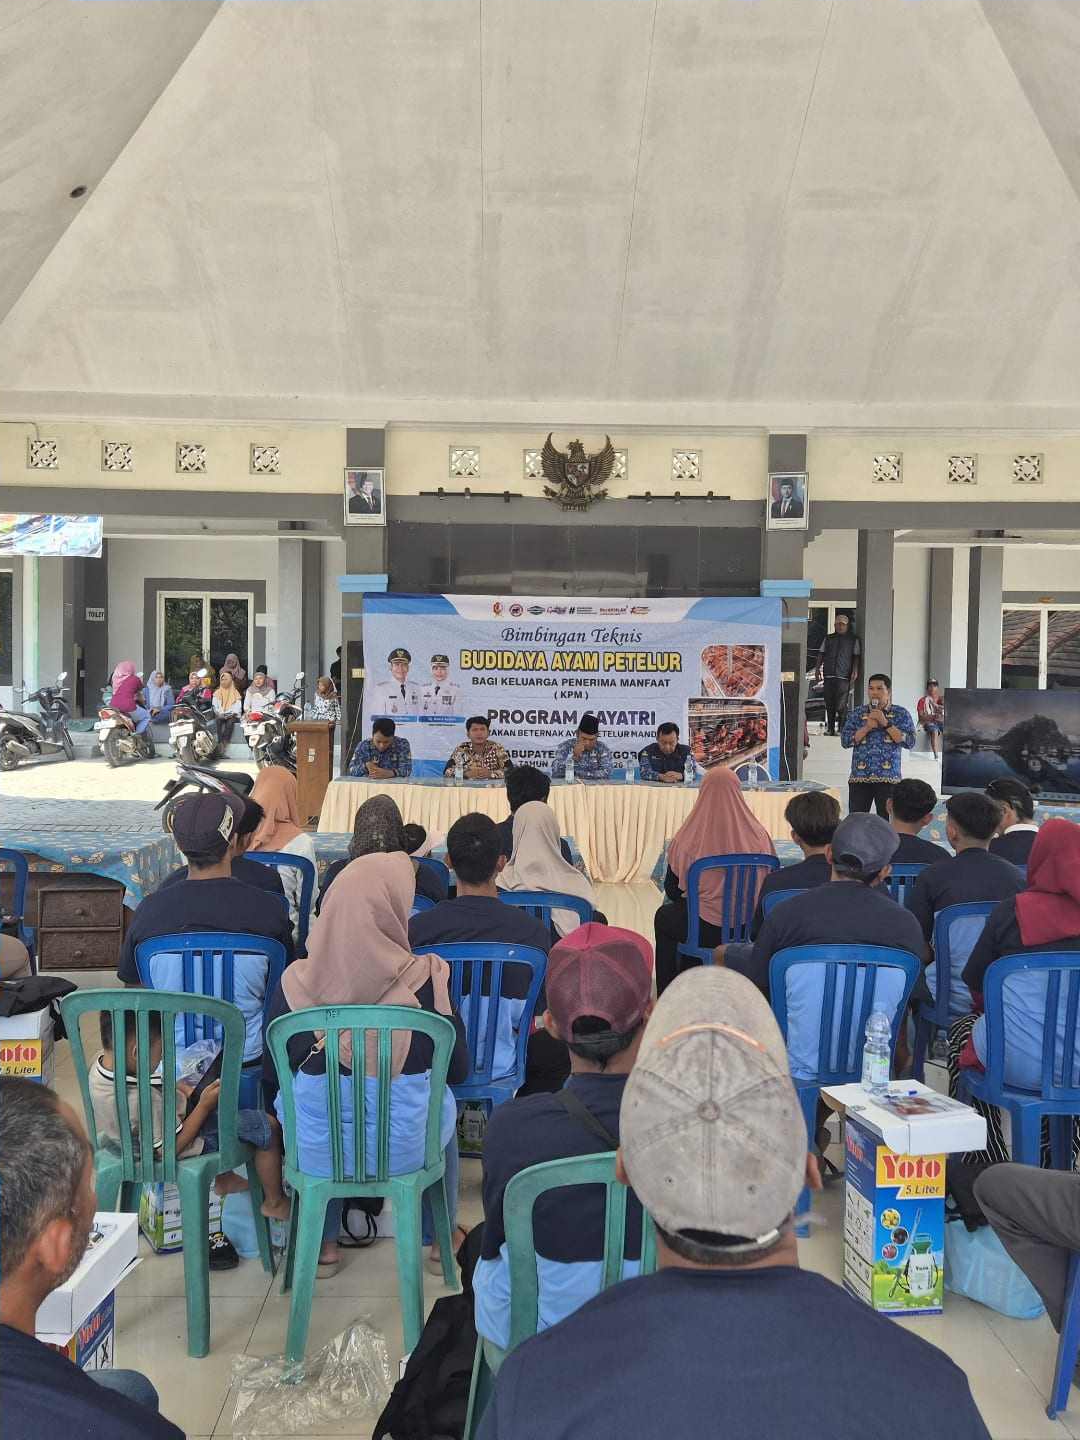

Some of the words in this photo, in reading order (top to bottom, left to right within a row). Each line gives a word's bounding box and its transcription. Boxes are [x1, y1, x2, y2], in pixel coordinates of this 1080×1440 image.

[501, 627, 586, 647] Bimbingan
[591, 627, 642, 646] Teknis
[459, 649, 548, 671] BUDIDAYA
[551, 650, 600, 672] AYAM
[603, 651, 683, 673] PETELUR
[472, 677, 498, 686] BAGI
[501, 677, 559, 687] KELUARGA
[562, 678, 617, 687] PENERIMA
[620, 678, 671, 688] MANFAAT
[487, 709, 578, 725] PROGRAM
[588, 710, 656, 726] AYATRI
[518, 729, 564, 738] BETERNAK
[599, 730, 630, 738] ETELUR
[506, 749, 554, 759] ABUPATE
[0, 1043, 37, 1062] oto
[882, 1155, 941, 1180] Yoto
[906, 1185, 912, 1194] 5
[916, 1185, 940, 1194] Liter
